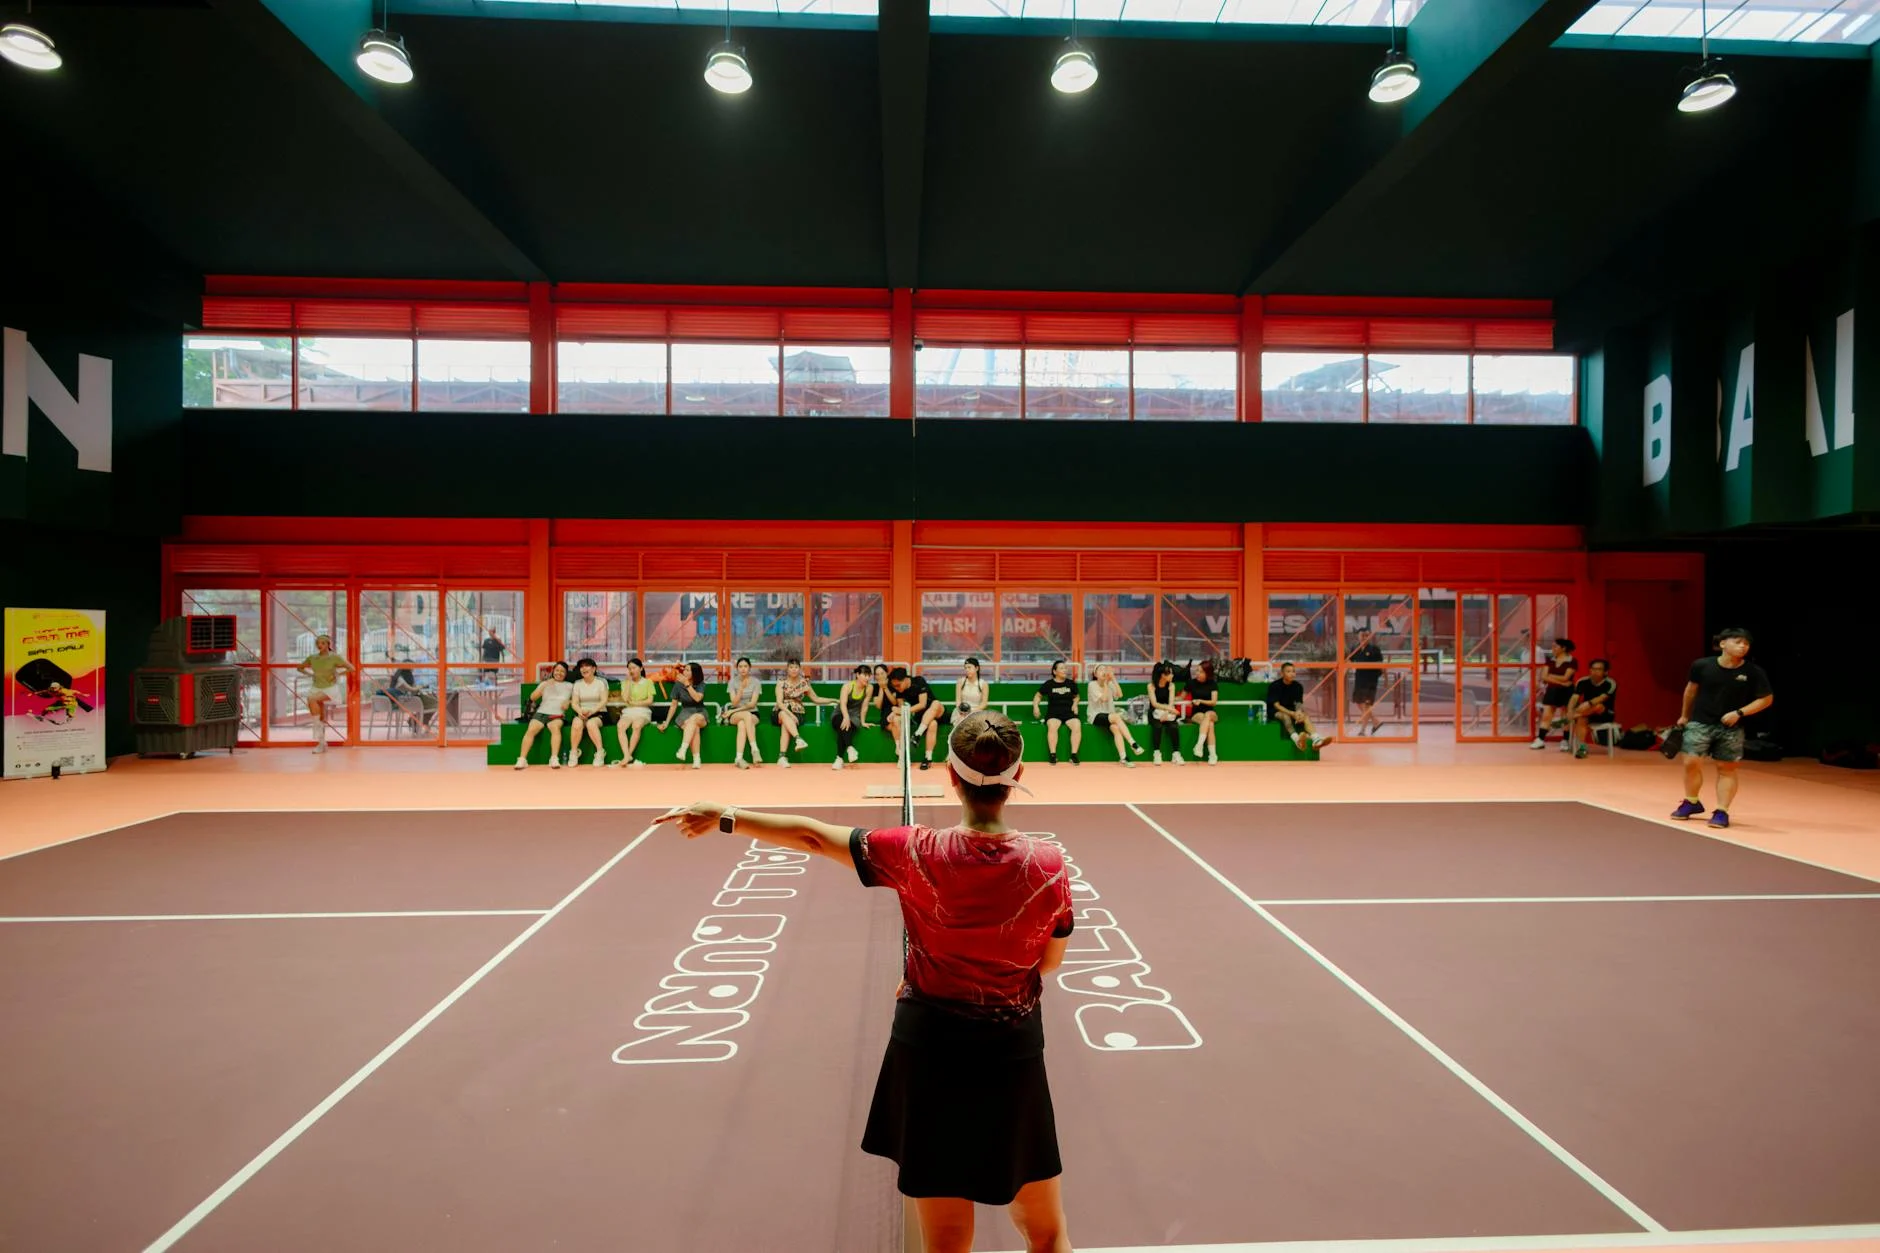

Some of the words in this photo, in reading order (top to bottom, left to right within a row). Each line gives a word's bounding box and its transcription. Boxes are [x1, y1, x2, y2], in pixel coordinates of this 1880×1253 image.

[3, 326, 113, 473] N
[921, 617, 977, 634] SMASH
[992, 617, 1037, 634] ARD
[1326, 615, 1408, 634] NLY
[611, 914, 788, 1065] BURN
